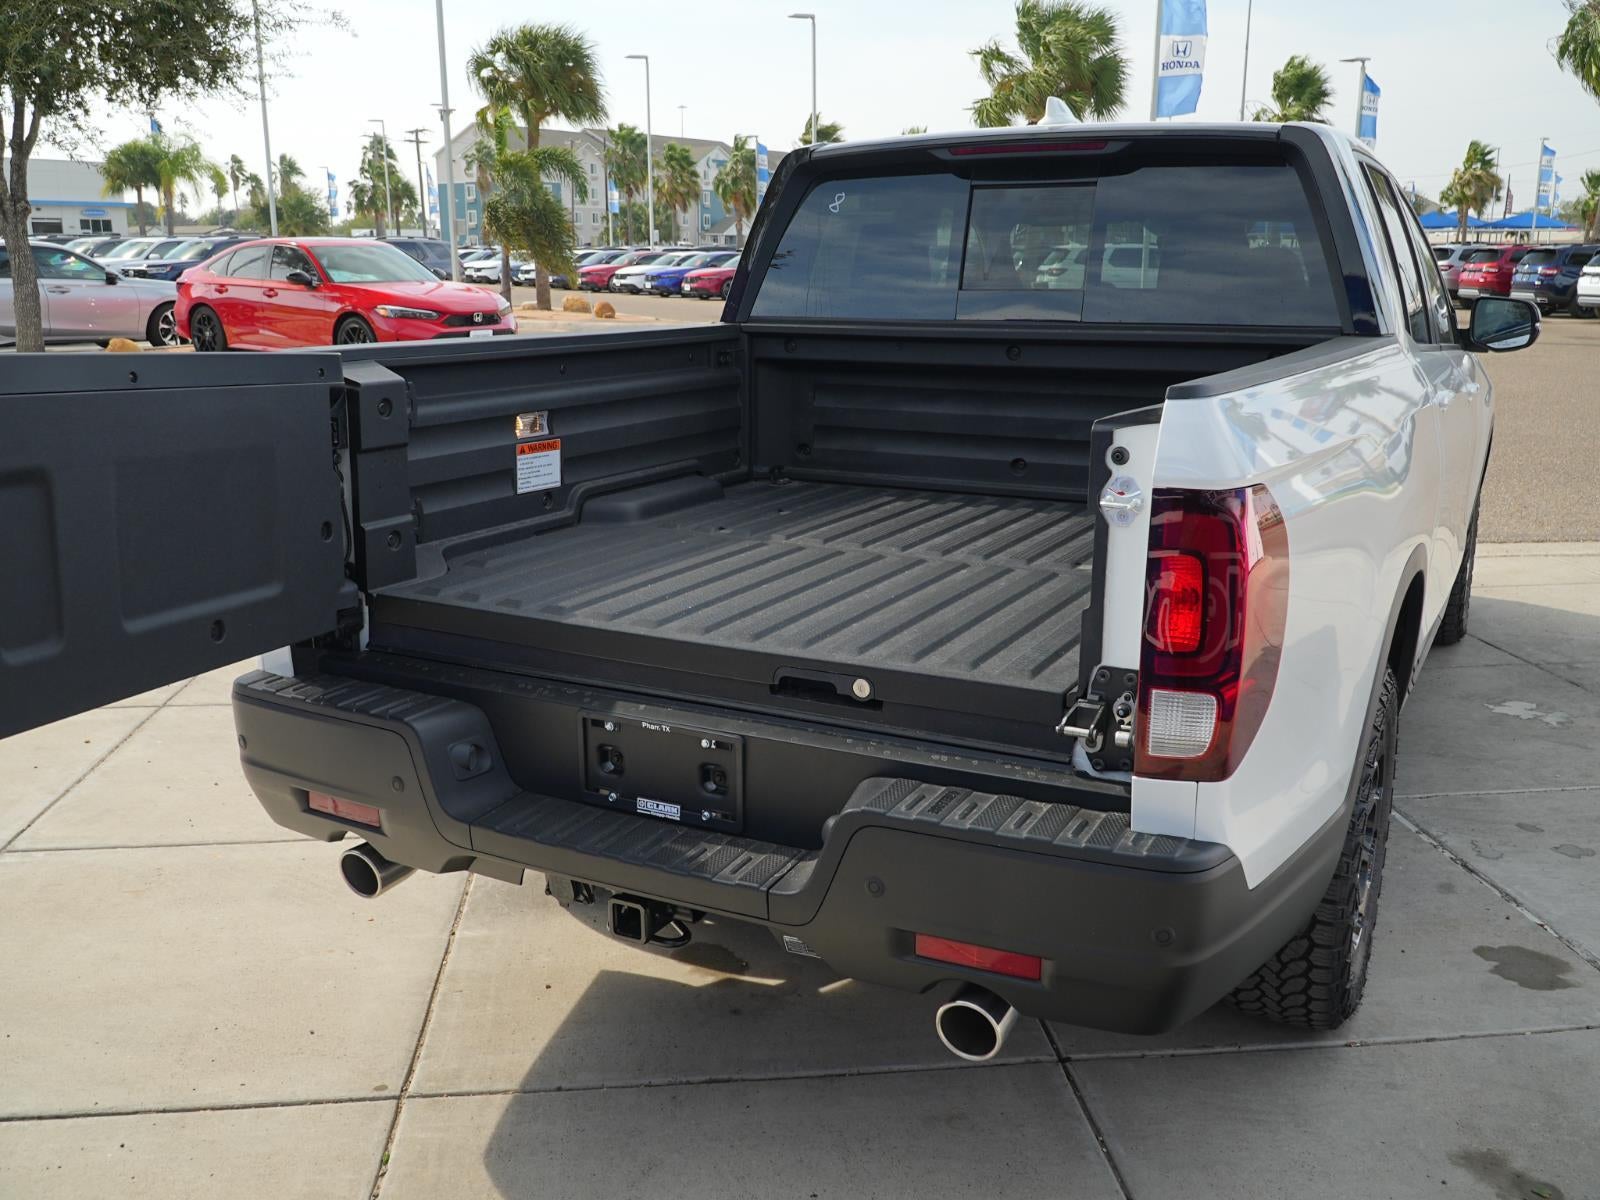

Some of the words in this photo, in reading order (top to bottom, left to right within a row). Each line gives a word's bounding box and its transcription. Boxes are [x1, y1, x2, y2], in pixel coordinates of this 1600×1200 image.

[1161, 60, 1200, 71] HONDA
[829, 192, 845, 213] 8
[528, 441, 559, 453] WARNING
[661, 725, 671, 733] TX
[646, 801, 678, 814] CLARK
